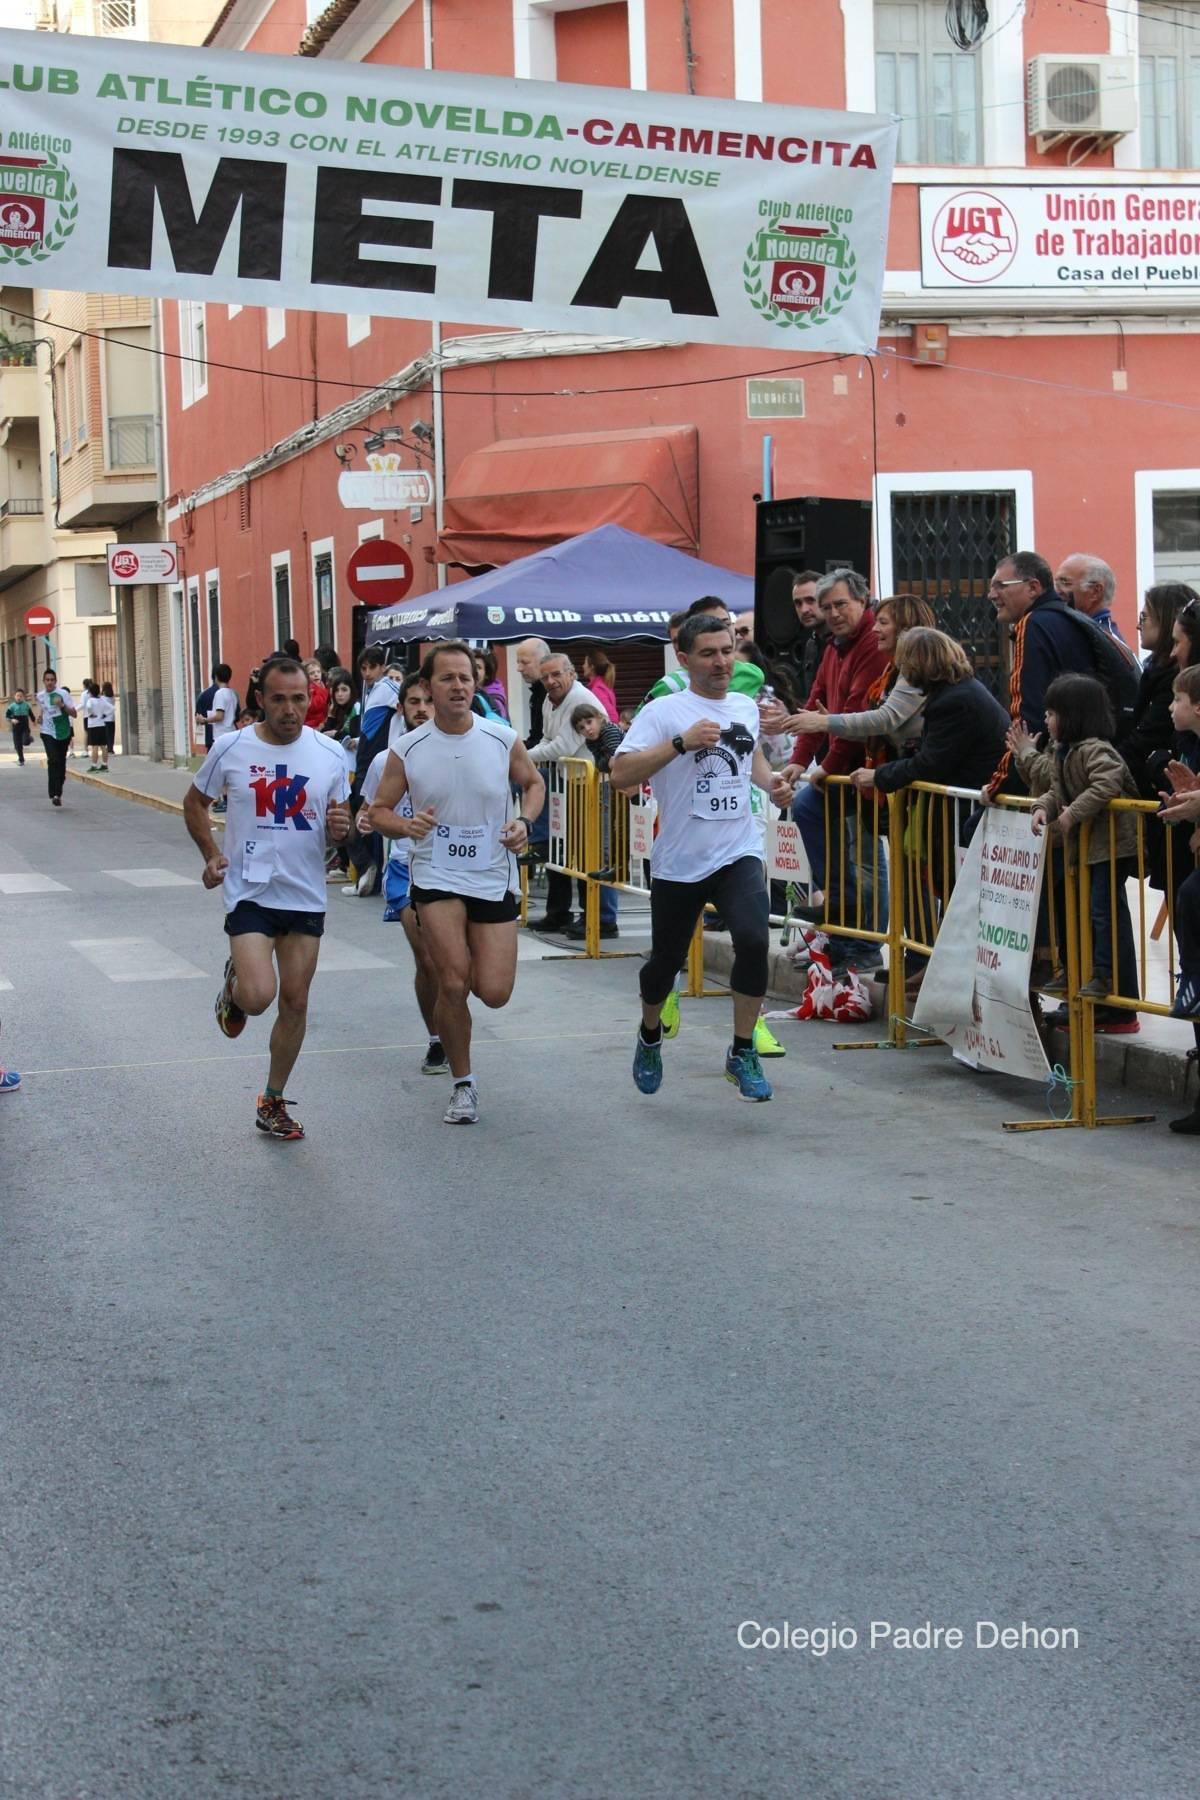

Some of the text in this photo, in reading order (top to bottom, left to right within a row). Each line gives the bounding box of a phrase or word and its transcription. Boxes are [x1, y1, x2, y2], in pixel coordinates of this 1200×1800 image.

[96, 71, 328, 119] ATLÉTICO
[8, 131, 72, 154] Atlético
[117, 117, 721, 188] DESDE 1993 CON EL ATLETISMO NOVELDENSE
[0, 169, 57, 198] velda
[758, 199, 853, 224] Club Atlético
[1046, 193, 1200, 221] Unión Gener
[108, 147, 719, 317] META
[946, 207, 1002, 237] UGT
[766, 238, 838, 265] Novelda
[1036, 229, 1065, 256] de
[1057, 266, 1200, 280] Casa del Puebl
[514, 607, 582, 624] Club
[710, 796, 738, 811] 915
[448, 843, 477, 858] 908
